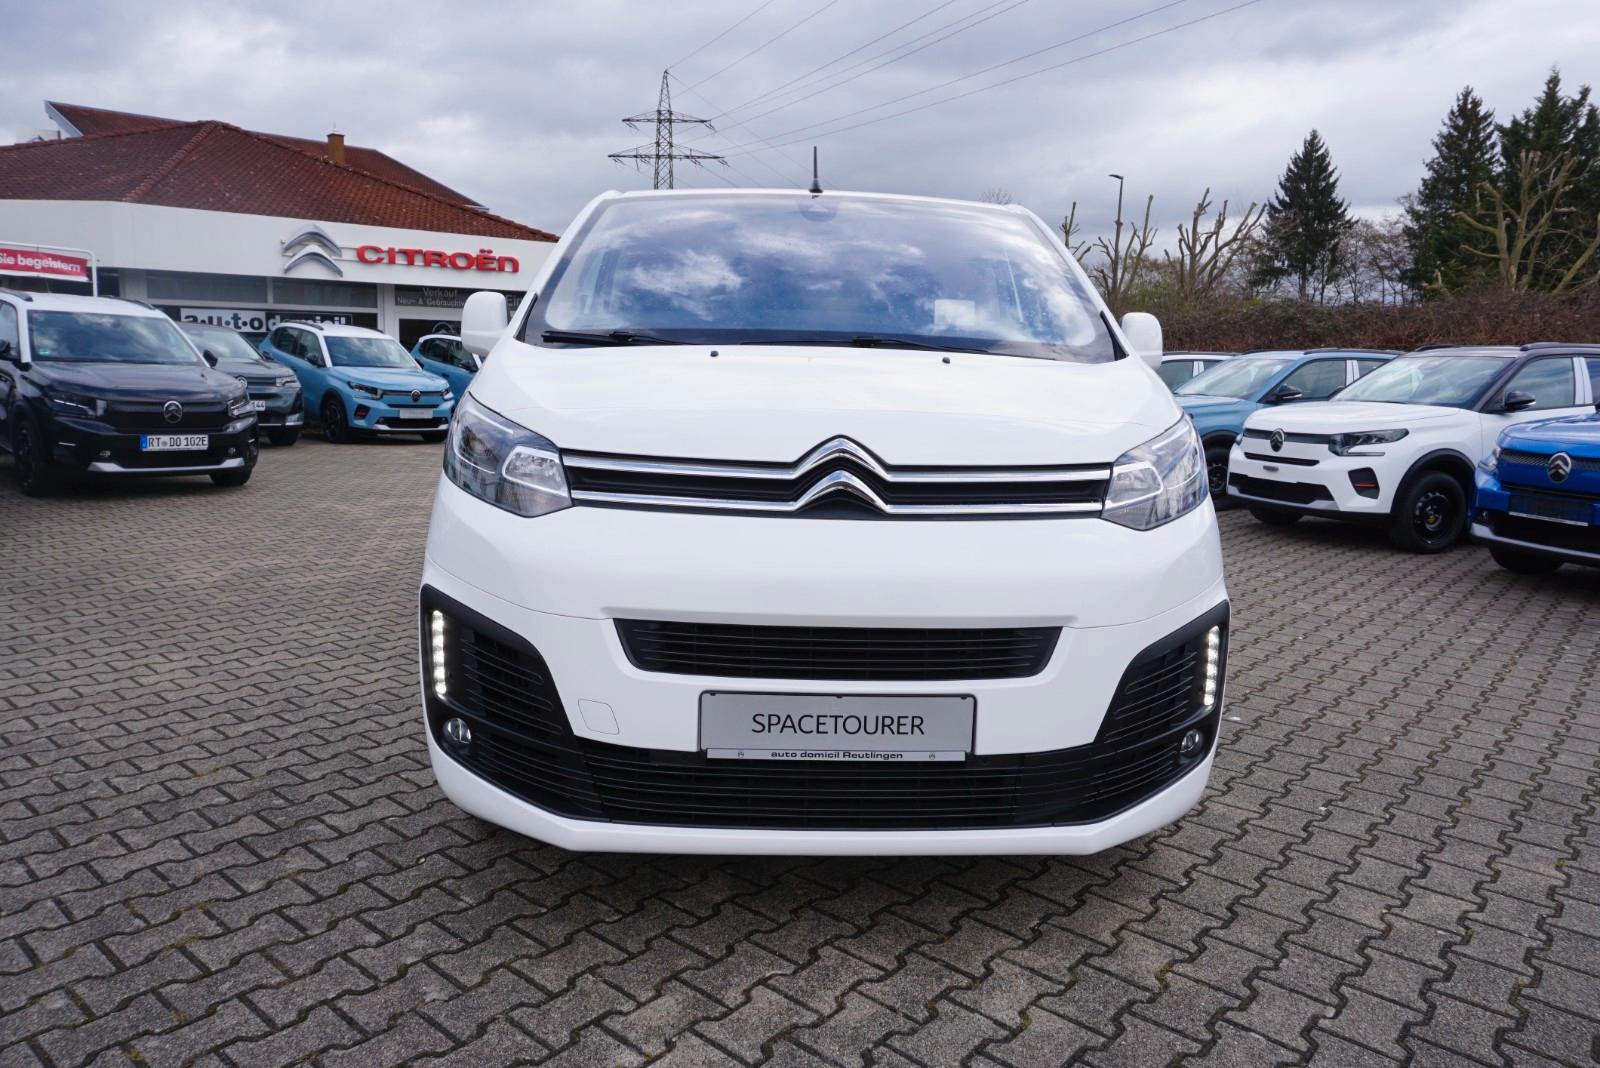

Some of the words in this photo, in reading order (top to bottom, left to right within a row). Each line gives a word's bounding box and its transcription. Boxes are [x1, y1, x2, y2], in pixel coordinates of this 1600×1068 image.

[17, 254, 80, 272] begeistern
[422, 288, 457, 299] Verkauf
[148, 436, 161, 448] RT
[183, 436, 208, 447] 102E
[751, 713, 925, 735] SPACETOURER
[800, 751, 840, 759] domicil
[842, 752, 903, 760] Reutlingen
